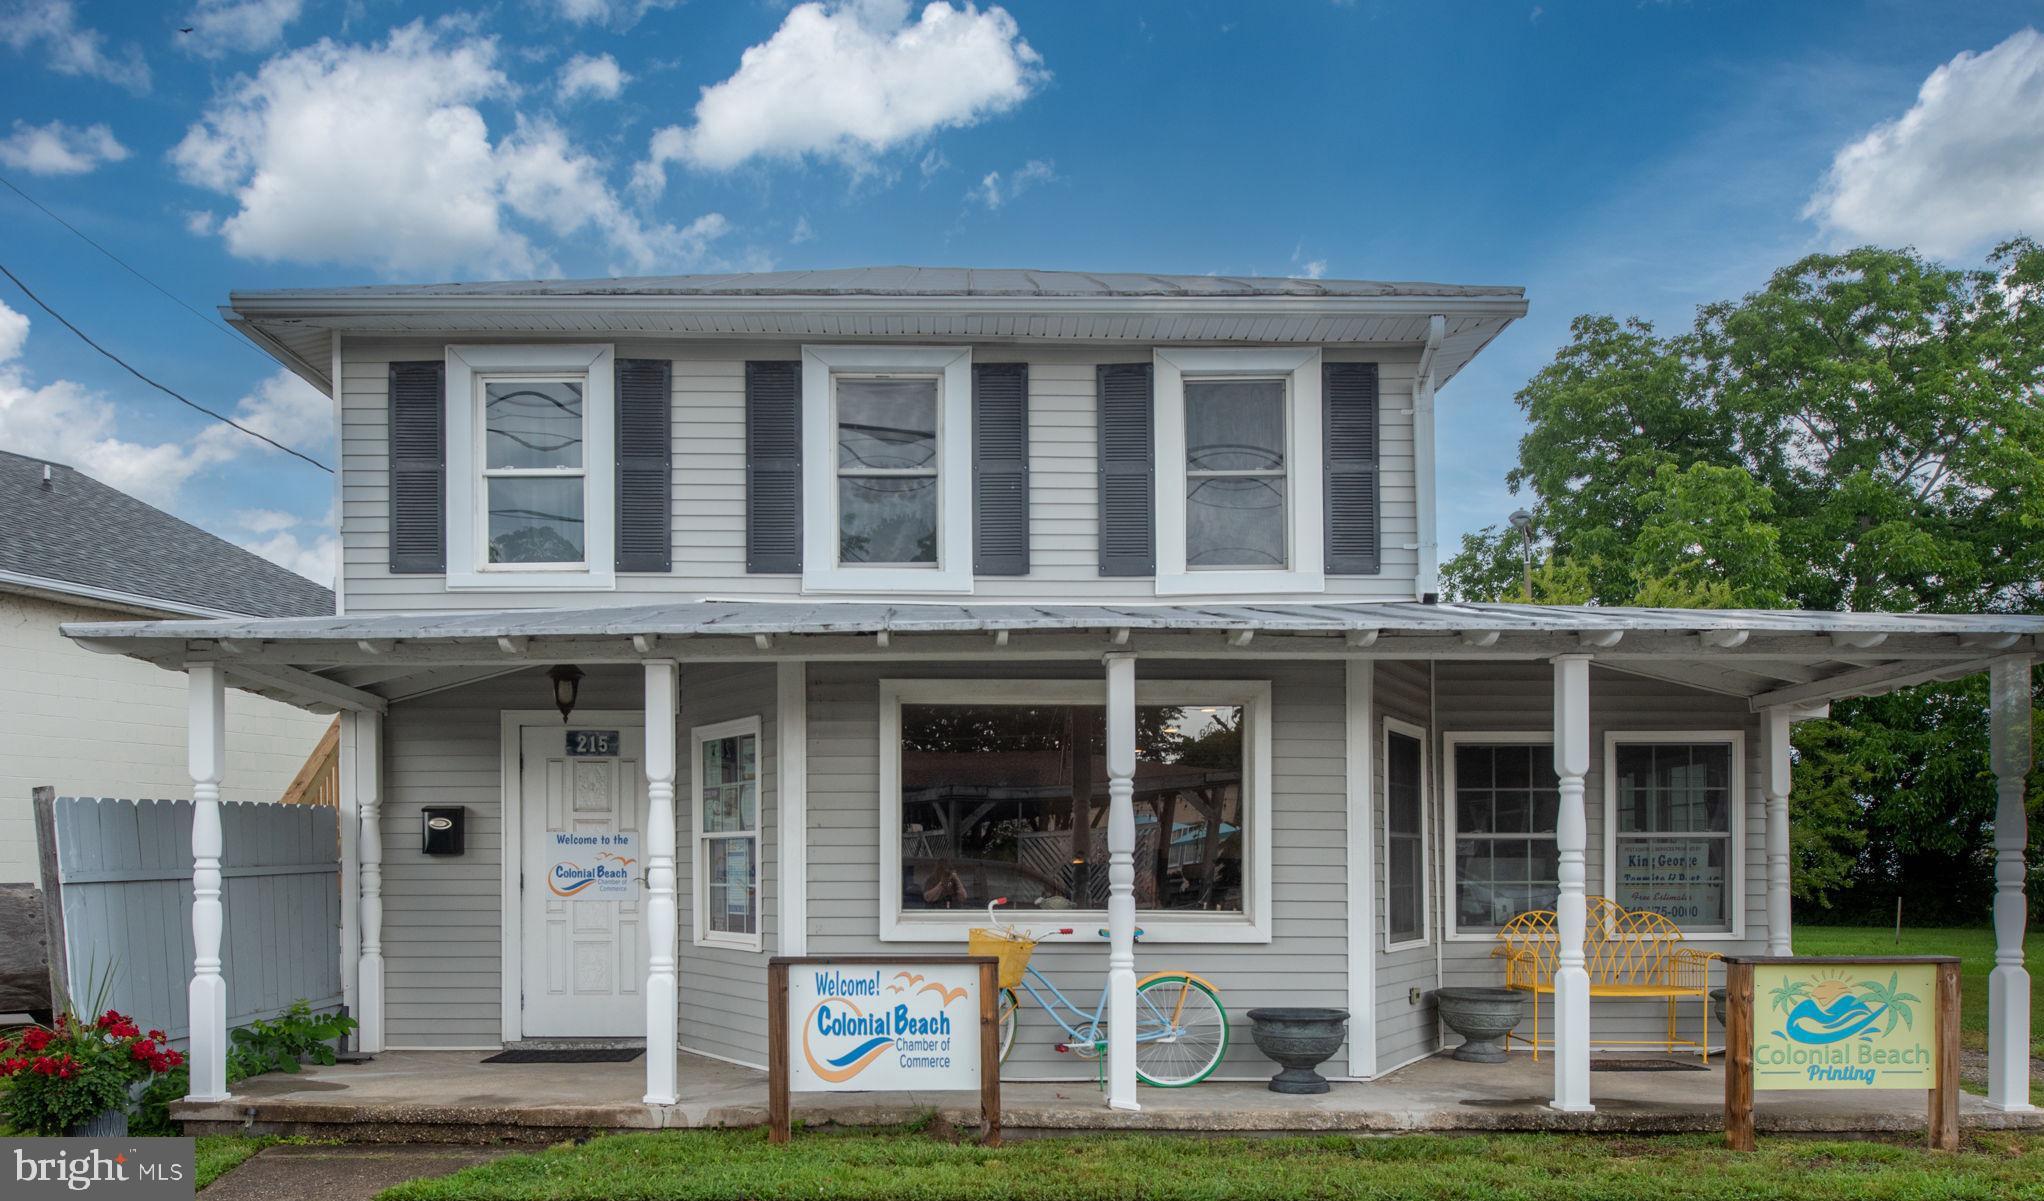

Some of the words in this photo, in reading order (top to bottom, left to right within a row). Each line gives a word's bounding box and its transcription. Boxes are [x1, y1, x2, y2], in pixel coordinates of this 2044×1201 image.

[577, 735, 608, 752] 215
[556, 834, 598, 844] Welcome
[601, 835, 610, 844] to
[613, 834, 629, 844] the
[556, 865, 596, 878] Colonial
[597, 865, 628, 878] Beach
[815, 970, 880, 996] Welcome!
[817, 1005, 890, 1036] Colonial
[894, 1003, 950, 1035] Beach
[896, 1037, 938, 1051] Chamber
[940, 1037, 950, 1051] of
[900, 1054, 950, 1068] Commerce
[1755, 1044, 1850, 1065] Colonial
[1858, 1043, 1930, 1065] Beach
[1807, 1064, 1876, 1085] Printing
